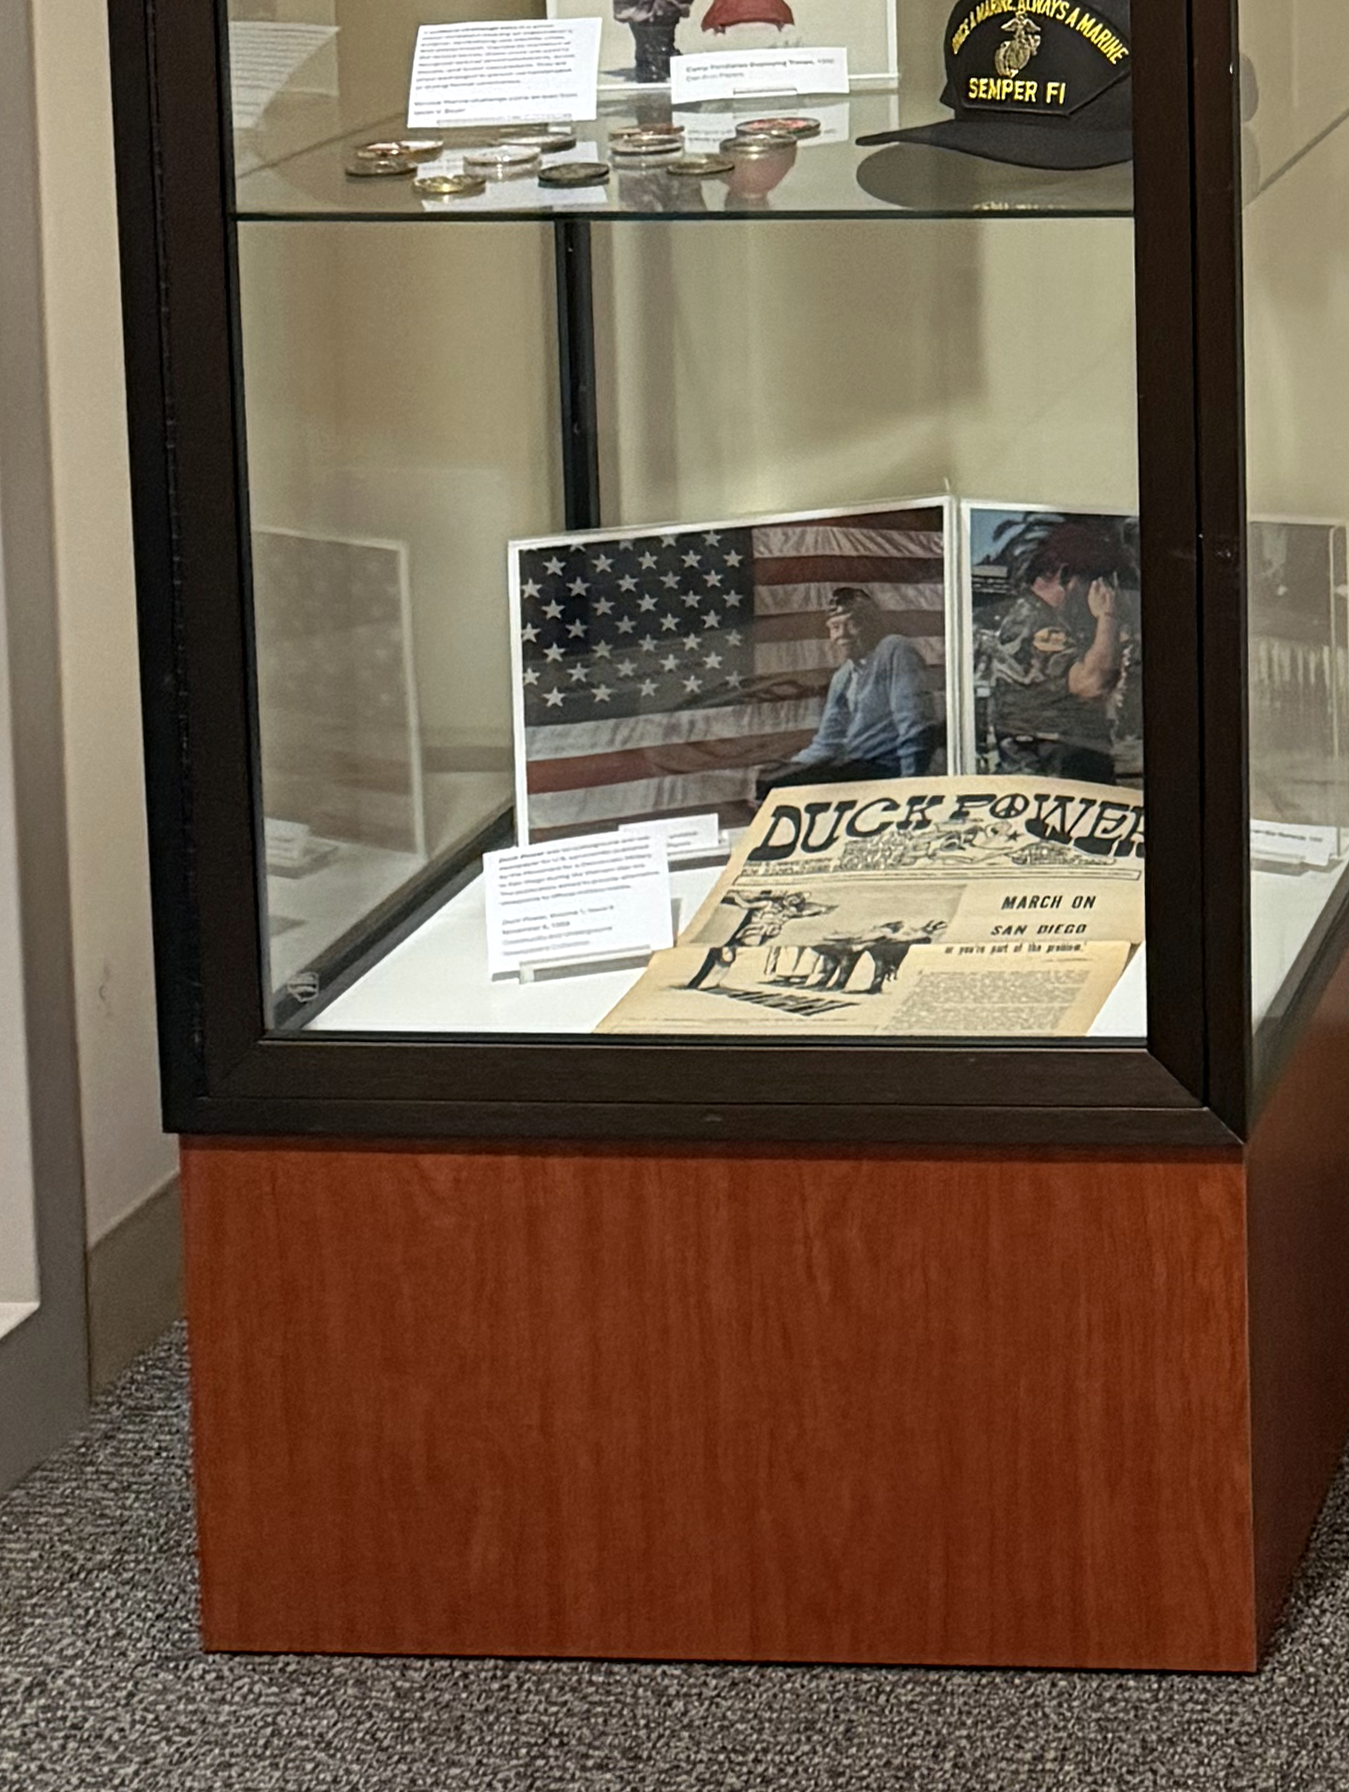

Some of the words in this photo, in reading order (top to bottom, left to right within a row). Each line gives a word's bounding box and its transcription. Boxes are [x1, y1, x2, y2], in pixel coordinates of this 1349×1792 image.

[1065, 7, 1080, 30] A
[1075, 13, 1129, 65] MARINE
[968, 78, 1038, 102] SEMPER
[1046, 82, 1066, 104] FI
[745, 794, 945, 862] DUCK
[1001, 895, 1062, 910] MARCH
[1071, 895, 1096, 910] ON
[991, 924, 1026, 936] SAN
[1037, 923, 1087, 935] DIEGO
[958, 945, 985, 957] you're
[1014, 943, 1024, 954] of
[1028, 943, 1041, 954] the
